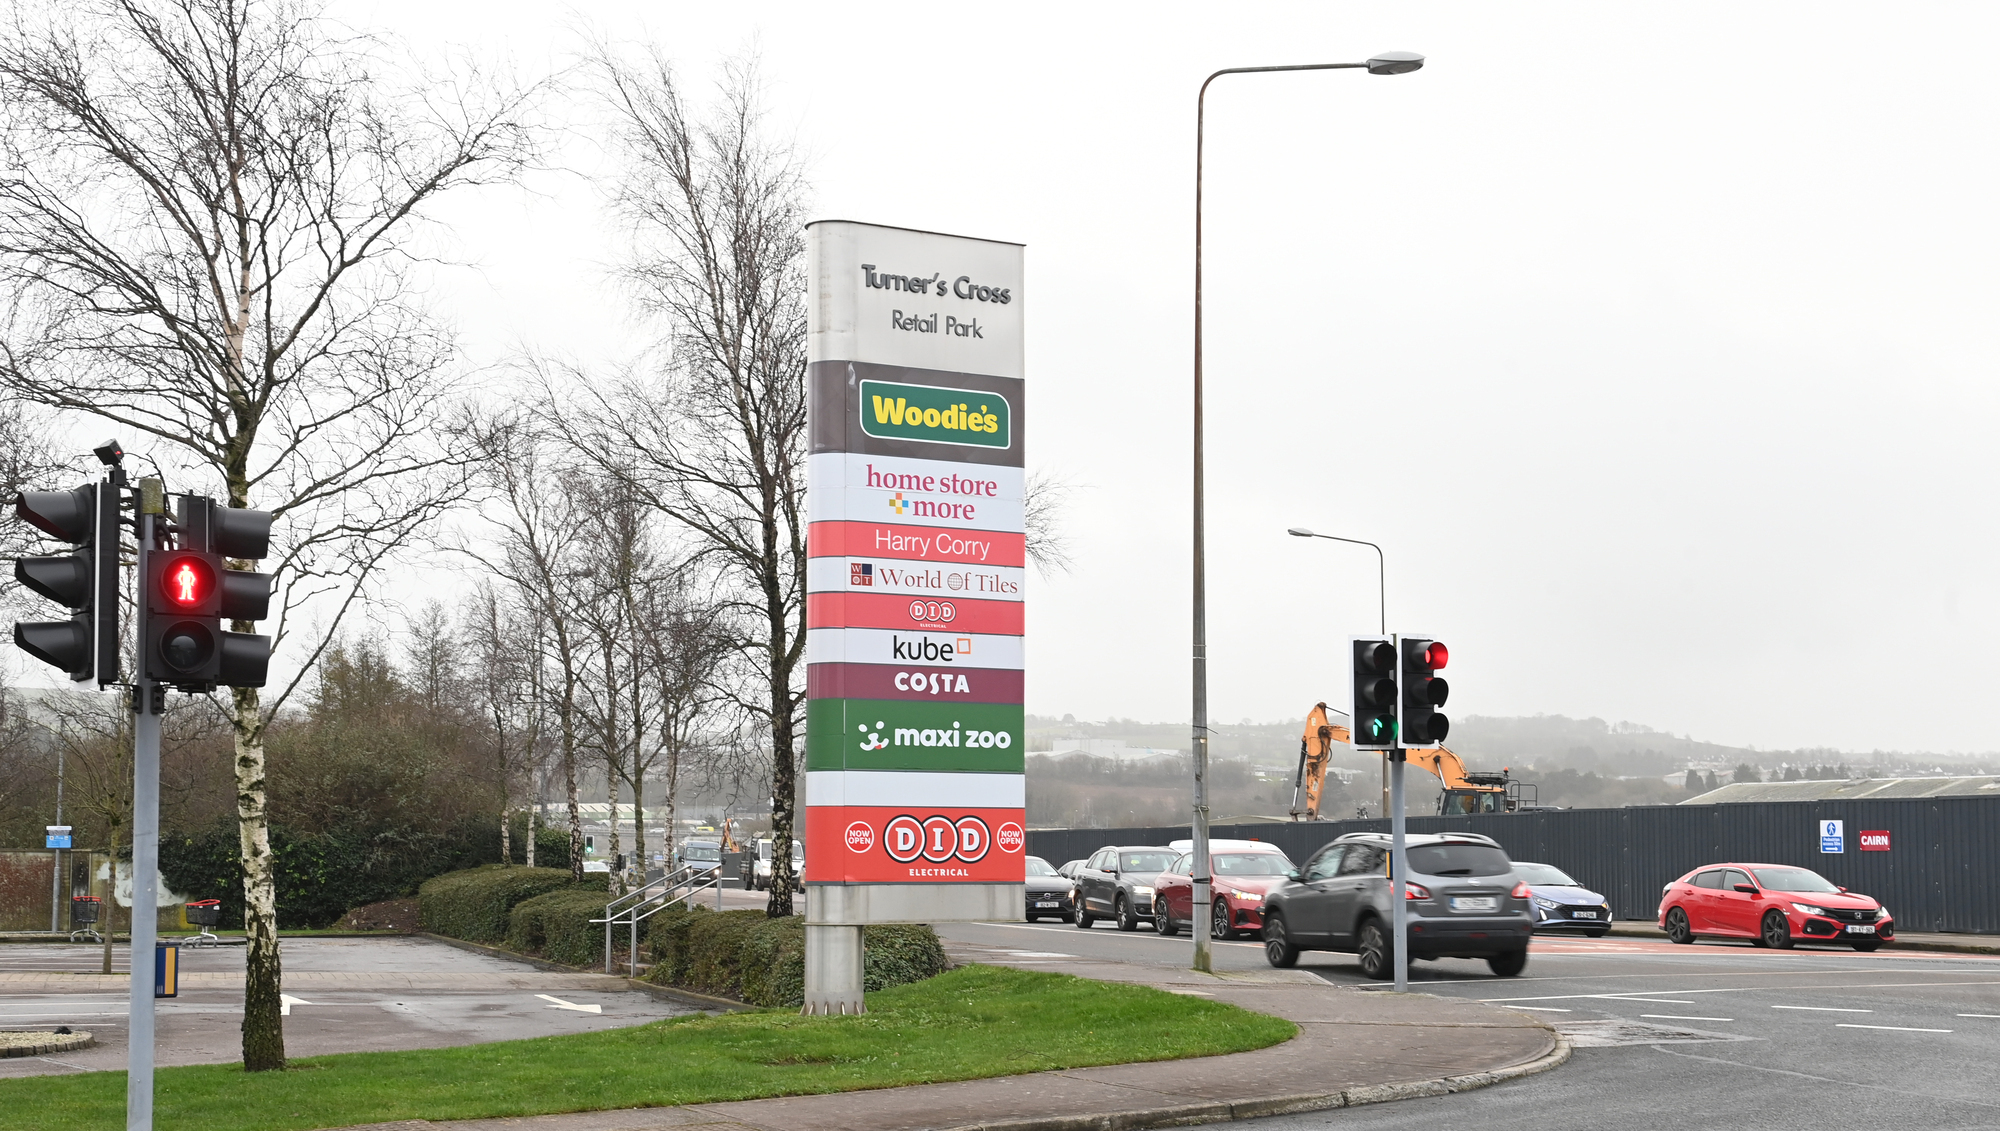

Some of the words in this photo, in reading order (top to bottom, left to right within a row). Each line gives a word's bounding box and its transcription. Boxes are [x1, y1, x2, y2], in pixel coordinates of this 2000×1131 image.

[861, 263, 948, 297] Turner's
[953, 275, 1012, 305] Cross
[892, 309, 938, 334] Retail
[945, 315, 984, 339] Park
[872, 394, 999, 434] Woodie's
[866, 464, 935, 492] home
[939, 473, 998, 497] store
[912, 499, 976, 521] more
[875, 529, 931, 557] Harry
[936, 533, 991, 561] Corry
[879, 568, 943, 589] World
[975, 574, 1019, 594] Tiles
[893, 635, 954, 662] kube
[894, 672, 971, 695] COSTA
[894, 720, 960, 748] maxi
[965, 730, 1012, 749] zoo
[848, 837, 871, 845] OPEN
[849, 829, 871, 838] NOW
[895, 827, 981, 852] DID
[1000, 837, 1021, 845] OPEN
[1001, 830, 1021, 838] NOW
[1860, 835, 1889, 846] CAIRN
[909, 868, 969, 877] ELECTRICAL
